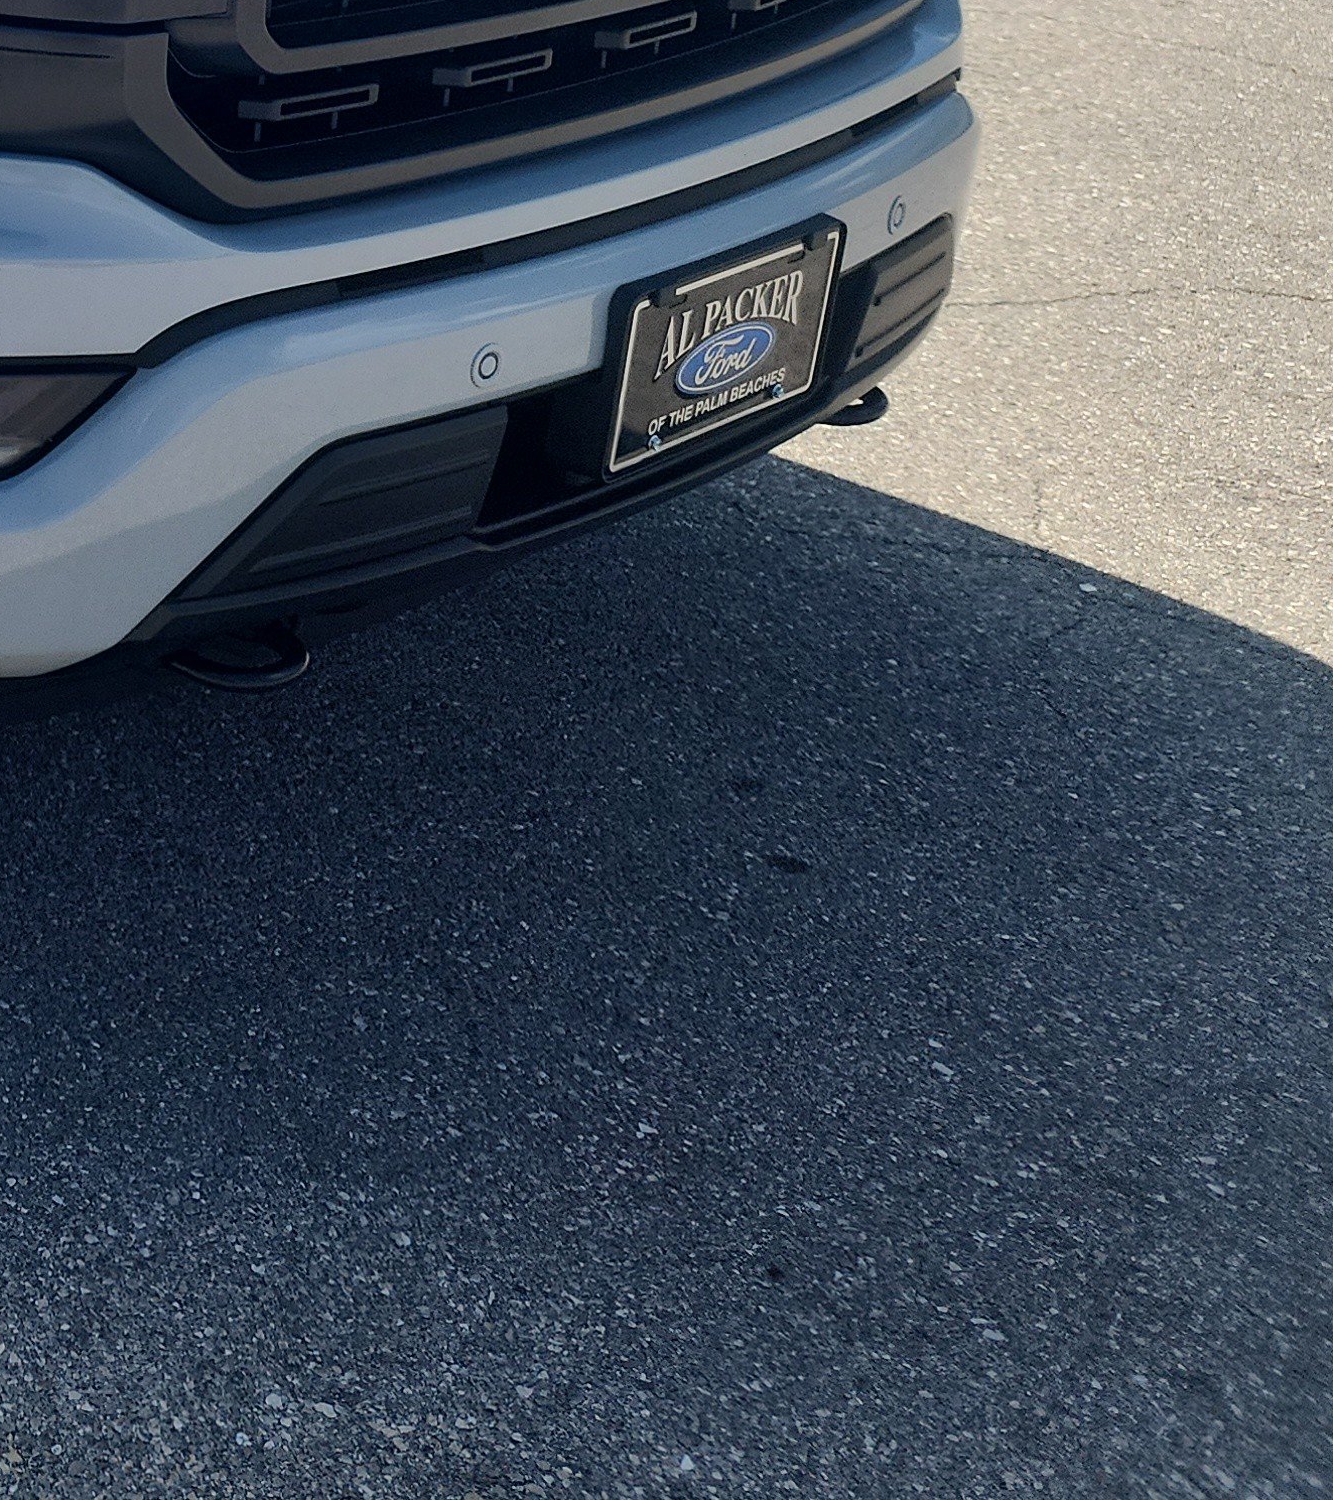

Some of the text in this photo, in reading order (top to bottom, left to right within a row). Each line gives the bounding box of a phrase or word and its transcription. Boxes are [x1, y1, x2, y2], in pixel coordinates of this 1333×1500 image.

[653, 269, 805, 382] AL PACKER
[694, 332, 757, 385] Ford
[647, 367, 786, 436] OF THE PALM BEACHES
